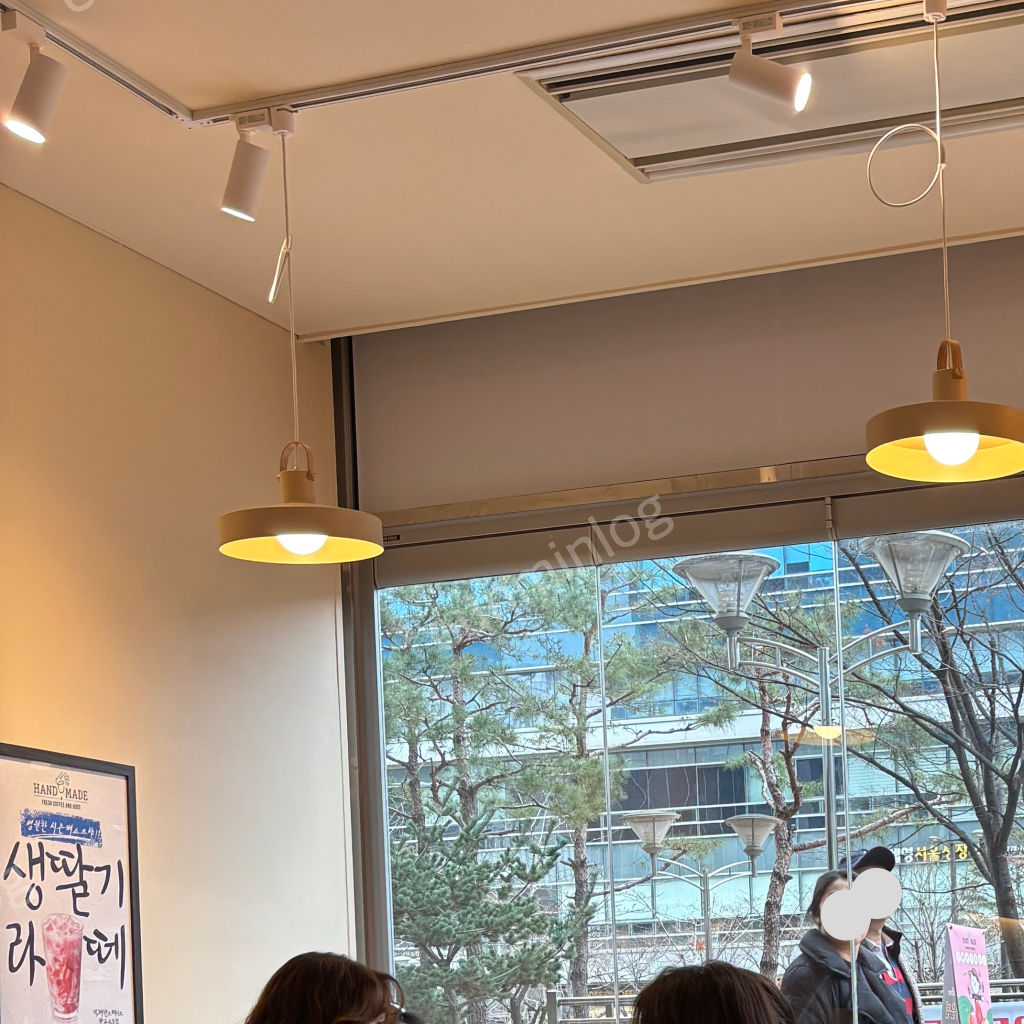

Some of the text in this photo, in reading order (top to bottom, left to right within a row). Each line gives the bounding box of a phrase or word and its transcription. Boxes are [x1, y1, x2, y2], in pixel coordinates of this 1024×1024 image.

[33, 782, 89, 801] HAND MADE
[3, 841, 124, 918] 생딸기
[5, 920, 126, 990] 라떼
